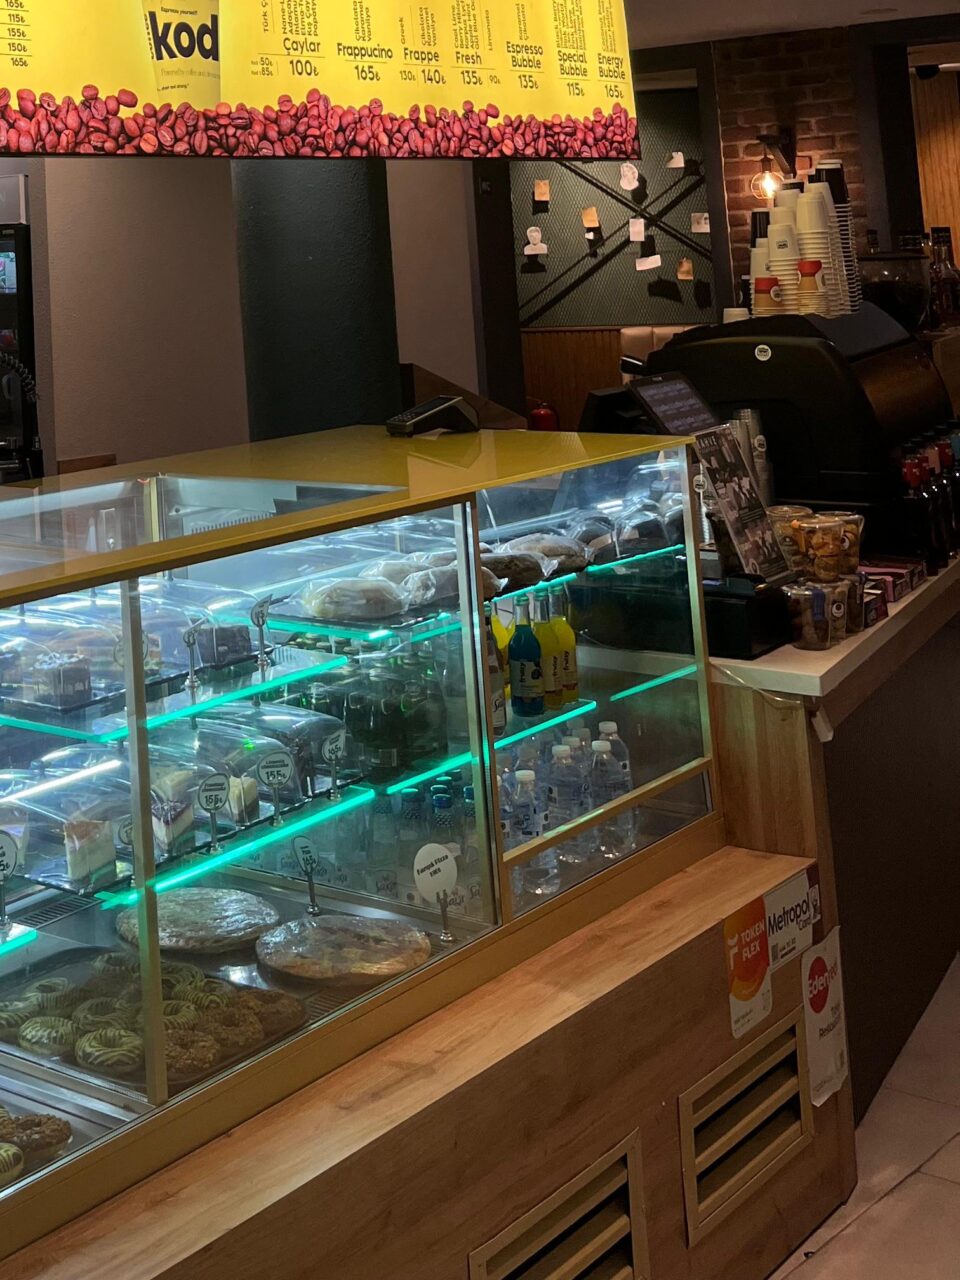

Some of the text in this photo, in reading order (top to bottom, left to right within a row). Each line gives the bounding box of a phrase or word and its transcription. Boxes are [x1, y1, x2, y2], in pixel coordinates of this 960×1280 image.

[148, 10, 220, 61] kod
[336, 42, 394, 60] Frappucino
[403, 46, 440, 64] Frappe
[506, 40, 544, 56] Espresso
[557, 50, 588, 64] Special
[455, 51, 482, 65] Fresh
[511, 55, 542, 69] Bubble
[597, 52, 623, 70] Energy
[559, 63, 588, 77] Bubble
[599, 66, 626, 80] Bubble
[767, 892, 811, 937] Metropol
[740, 919, 765, 945] TOKEN
[742, 940, 762, 962] FLEX
